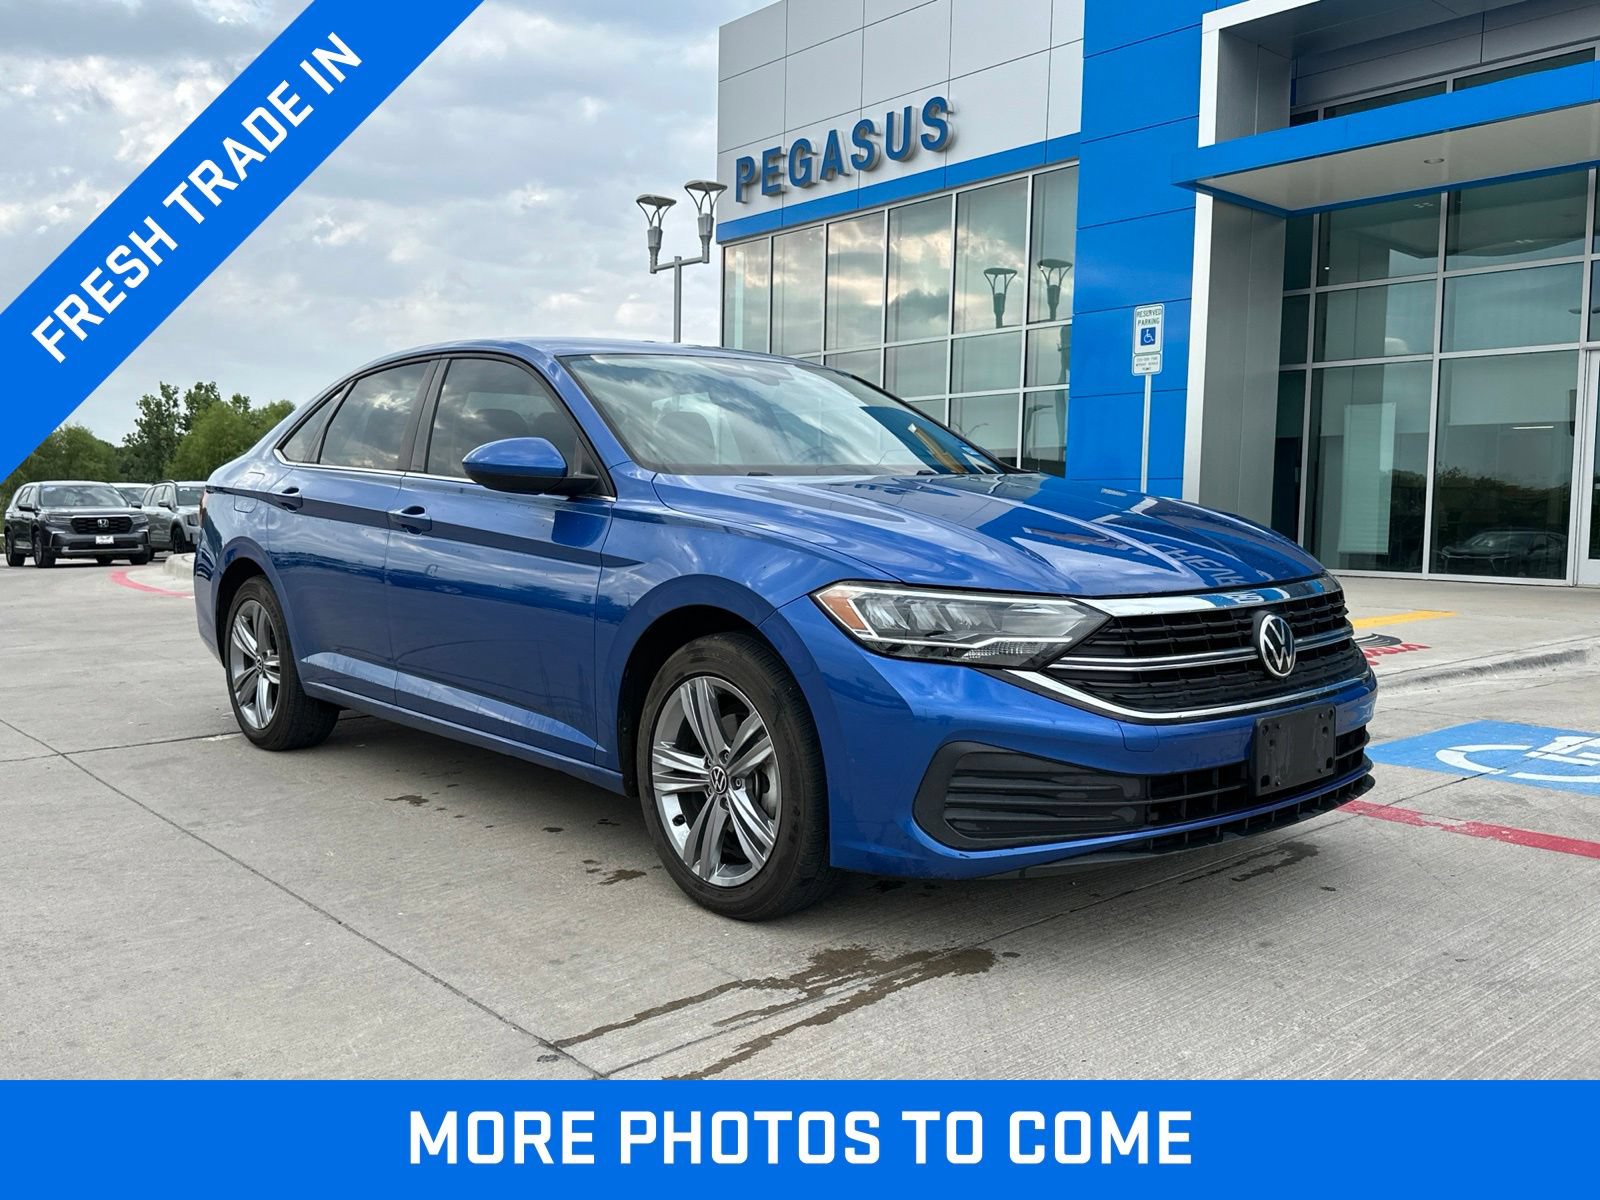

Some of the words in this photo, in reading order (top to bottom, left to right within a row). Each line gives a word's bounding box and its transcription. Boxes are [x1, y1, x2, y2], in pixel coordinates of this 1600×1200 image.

[735, 96, 953, 204] PEGASUS
[1136, 308, 1161, 318] RESERVED
[1137, 318, 1160, 326] PARKING
